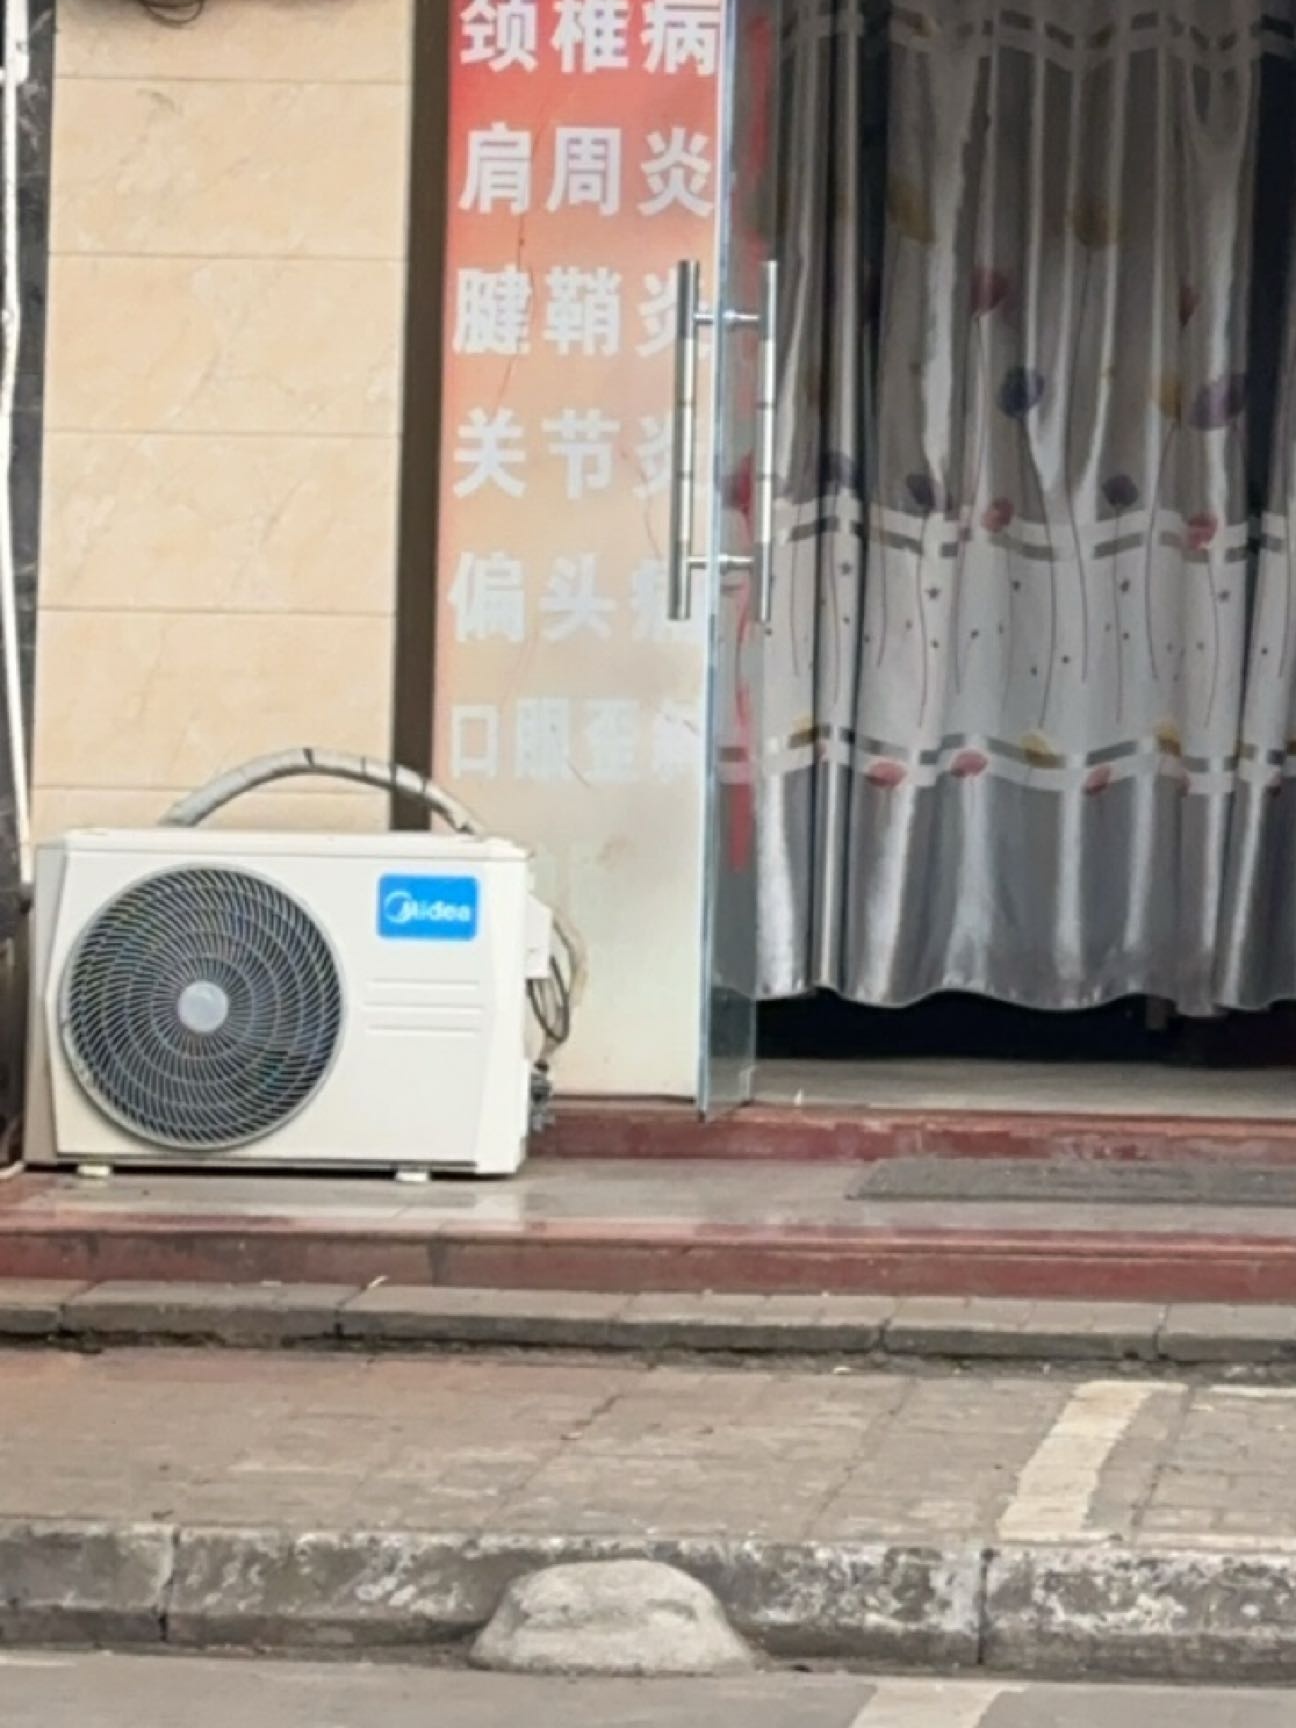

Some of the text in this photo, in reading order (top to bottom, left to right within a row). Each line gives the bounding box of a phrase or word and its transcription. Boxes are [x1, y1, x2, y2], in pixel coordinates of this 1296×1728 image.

[458, 123, 715, 218] 肩周炎
[386, 891, 471, 923] Midea
